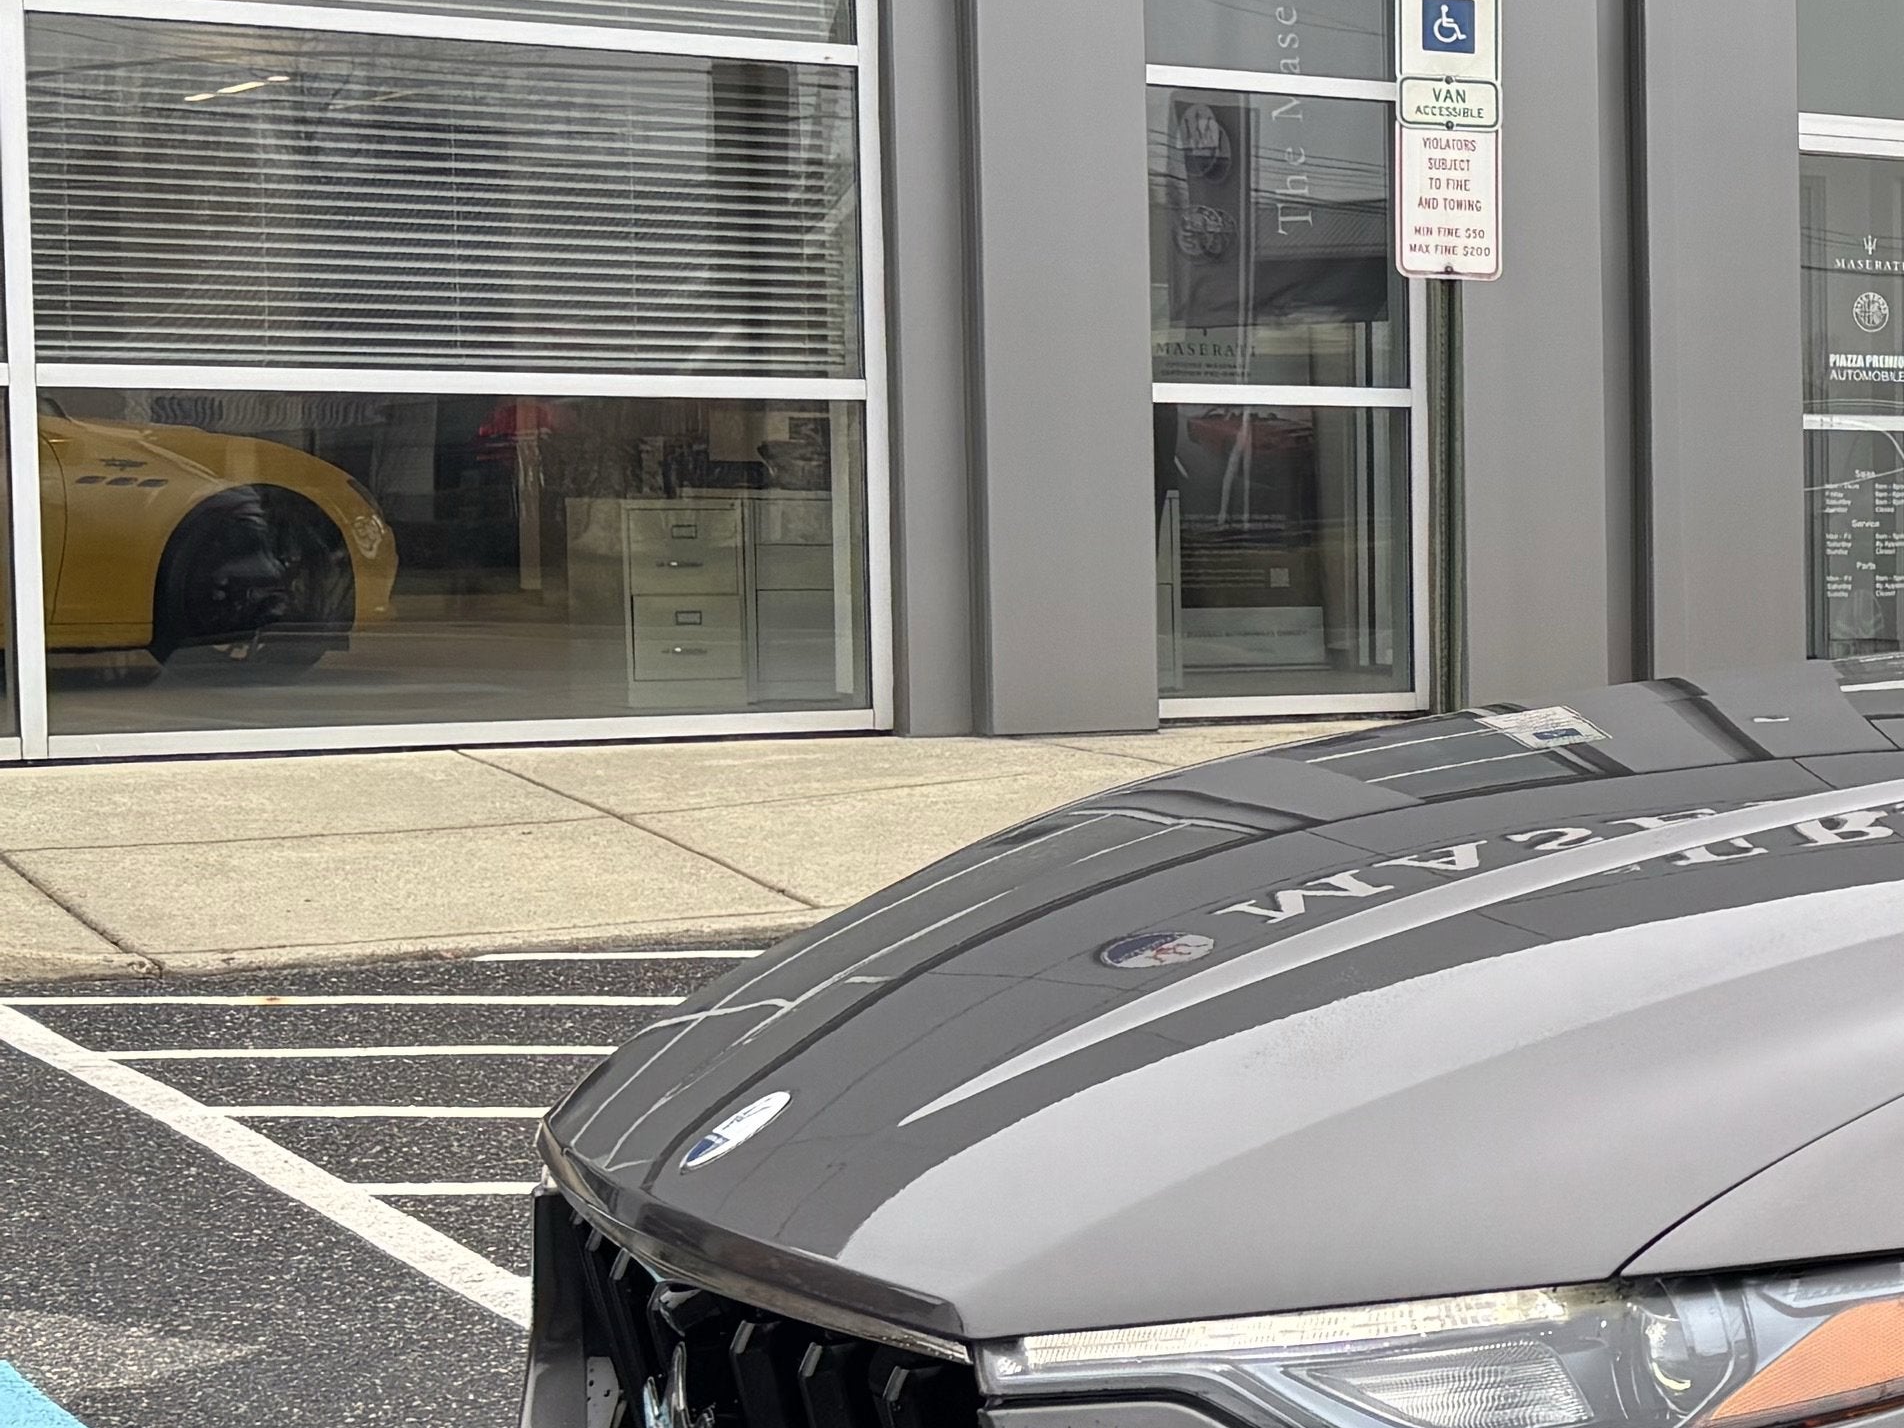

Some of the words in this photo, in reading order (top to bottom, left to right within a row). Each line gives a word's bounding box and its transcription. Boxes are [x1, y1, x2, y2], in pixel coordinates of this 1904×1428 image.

[1432, 87, 1467, 103] VAN
[1415, 105, 1485, 119] ACCESSIBLE
[1422, 137, 1477, 152] VIOLATORS
[1427, 157, 1471, 171] SUBJECT
[1276, 147, 1313, 235] The
[1428, 177, 1441, 190] TO
[1446, 178, 1471, 192] FINE
[1417, 197, 1439, 211] AND
[1443, 198, 1482, 212] TOWING
[1414, 226, 1433, 236] MIN
[1437, 227, 1461, 238] FINE
[1465, 228, 1485, 240] $50
[1409, 243, 1430, 255] MAX
[1435, 244, 1458, 256] FINE
[1462, 245, 1490, 257] $200
[1829, 353, 1864, 367] PIAZZA
